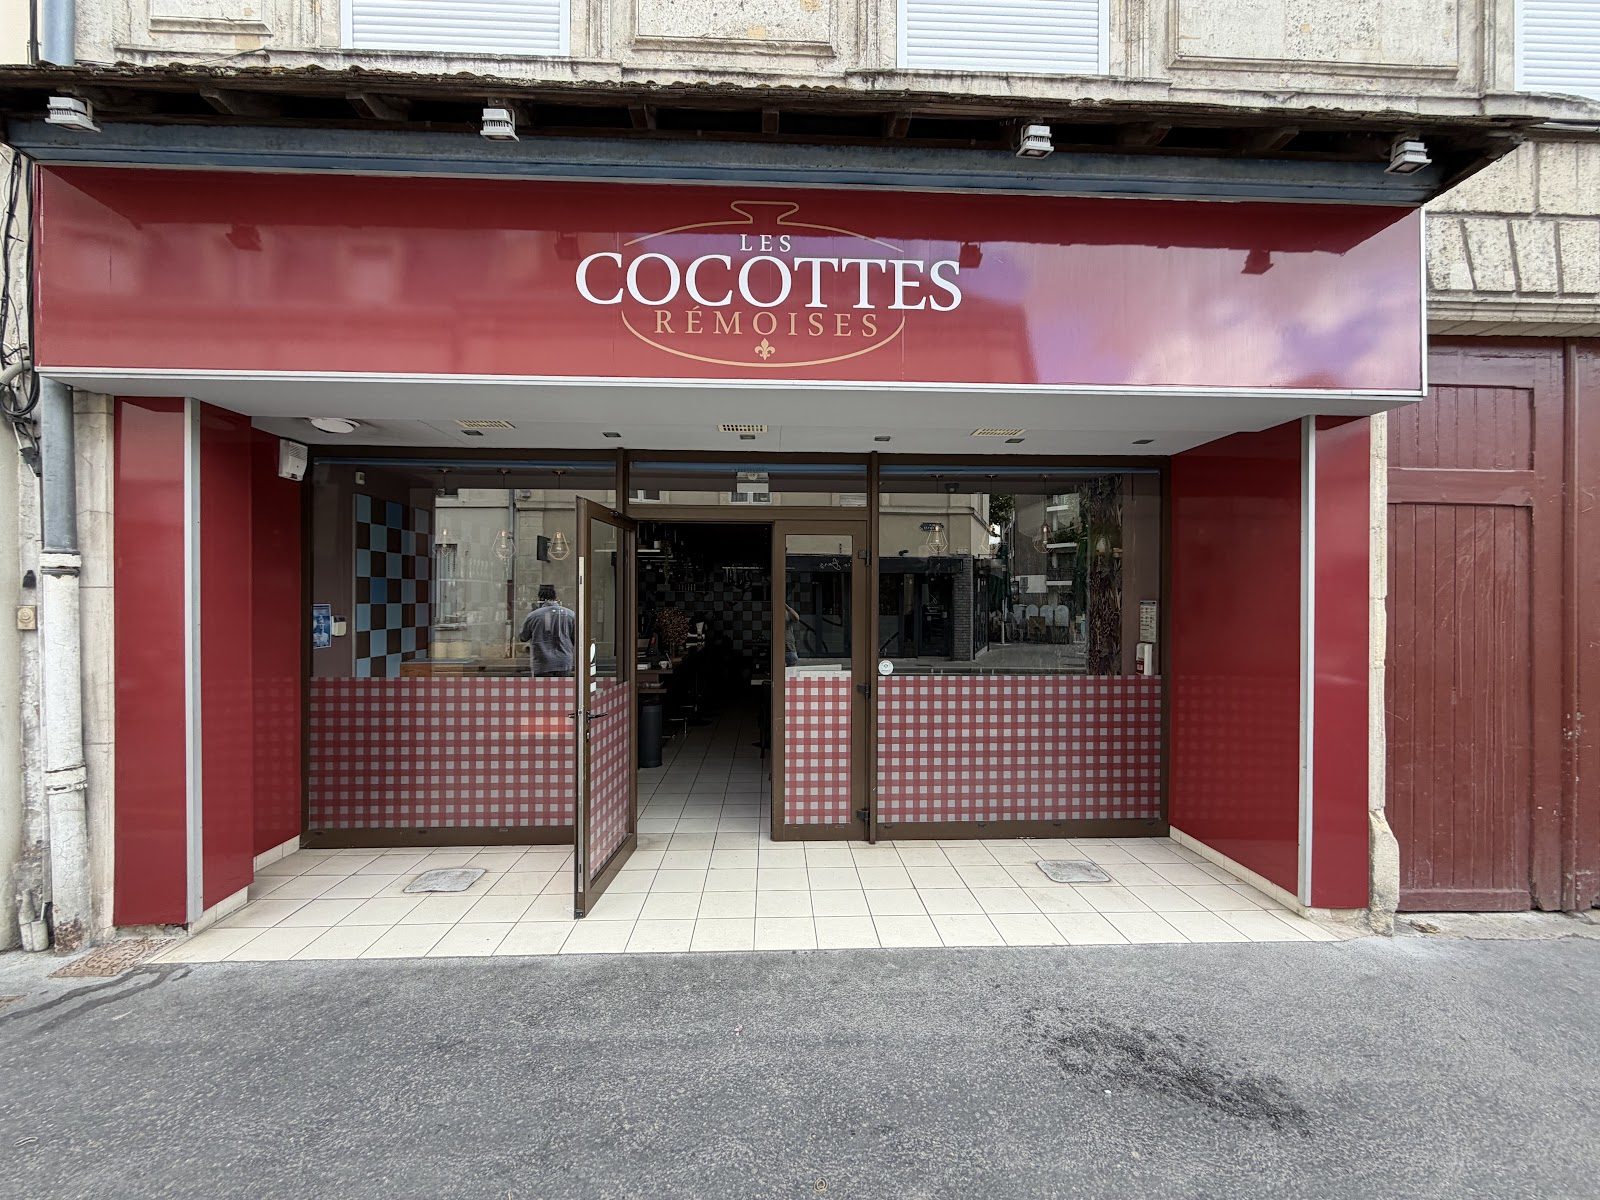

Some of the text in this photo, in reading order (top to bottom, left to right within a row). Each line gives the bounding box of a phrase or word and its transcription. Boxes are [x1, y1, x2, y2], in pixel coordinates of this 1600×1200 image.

[740, 234, 791, 252] LES
[575, 252, 962, 312] COCOTTES
[654, 306, 878, 337] RÉMOISES
